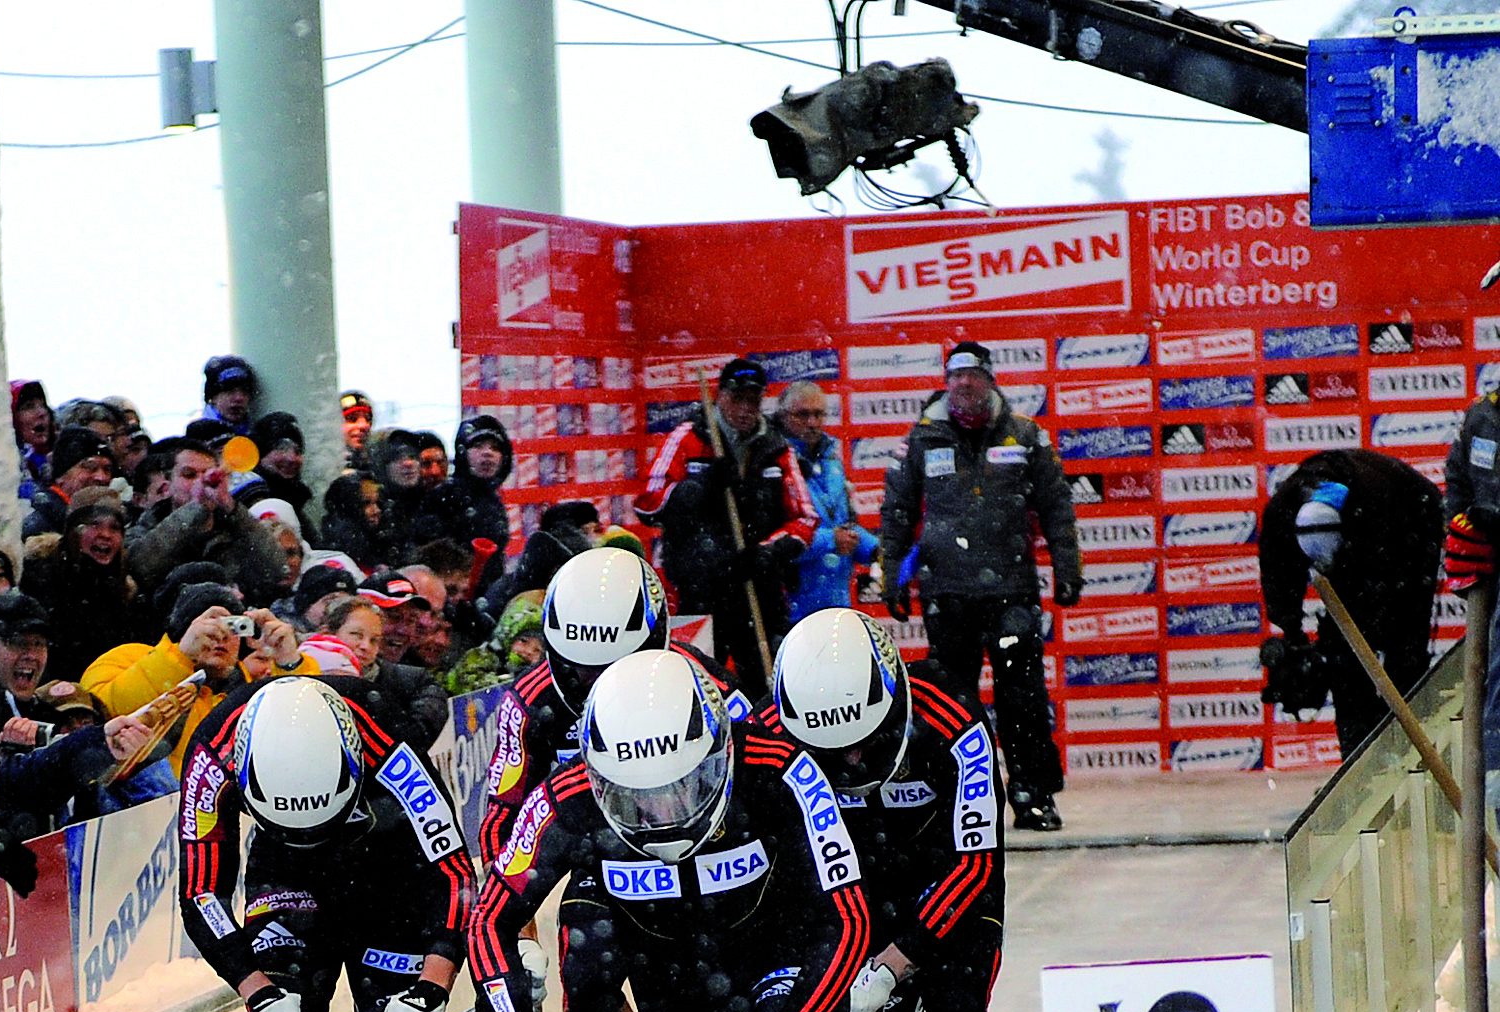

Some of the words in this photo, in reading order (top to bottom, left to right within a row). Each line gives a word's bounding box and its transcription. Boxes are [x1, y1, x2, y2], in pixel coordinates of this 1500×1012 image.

[1151, 205, 1217, 234] FIBT
[1225, 202, 1285, 231] Bob
[856, 232, 1123, 301] VIESSMANN
[1151, 242, 1242, 272] World
[1250, 240, 1311, 271] Cup
[1152, 279, 1338, 310] Winterberg
[565, 623, 619, 643] BMW
[805, 702, 862, 729] BMW
[616, 733, 679, 762] BMW
[273, 793, 331, 812] BMW
[380, 749, 452, 856] DKB.de
[888, 787, 933, 803] VISA
[958, 729, 992, 850] DKB.de
[789, 755, 851, 884] DKB.de
[607, 867, 675, 893] DKB
[706, 852, 766, 883] VISA
[83, 811, 178, 1005] BORBET
